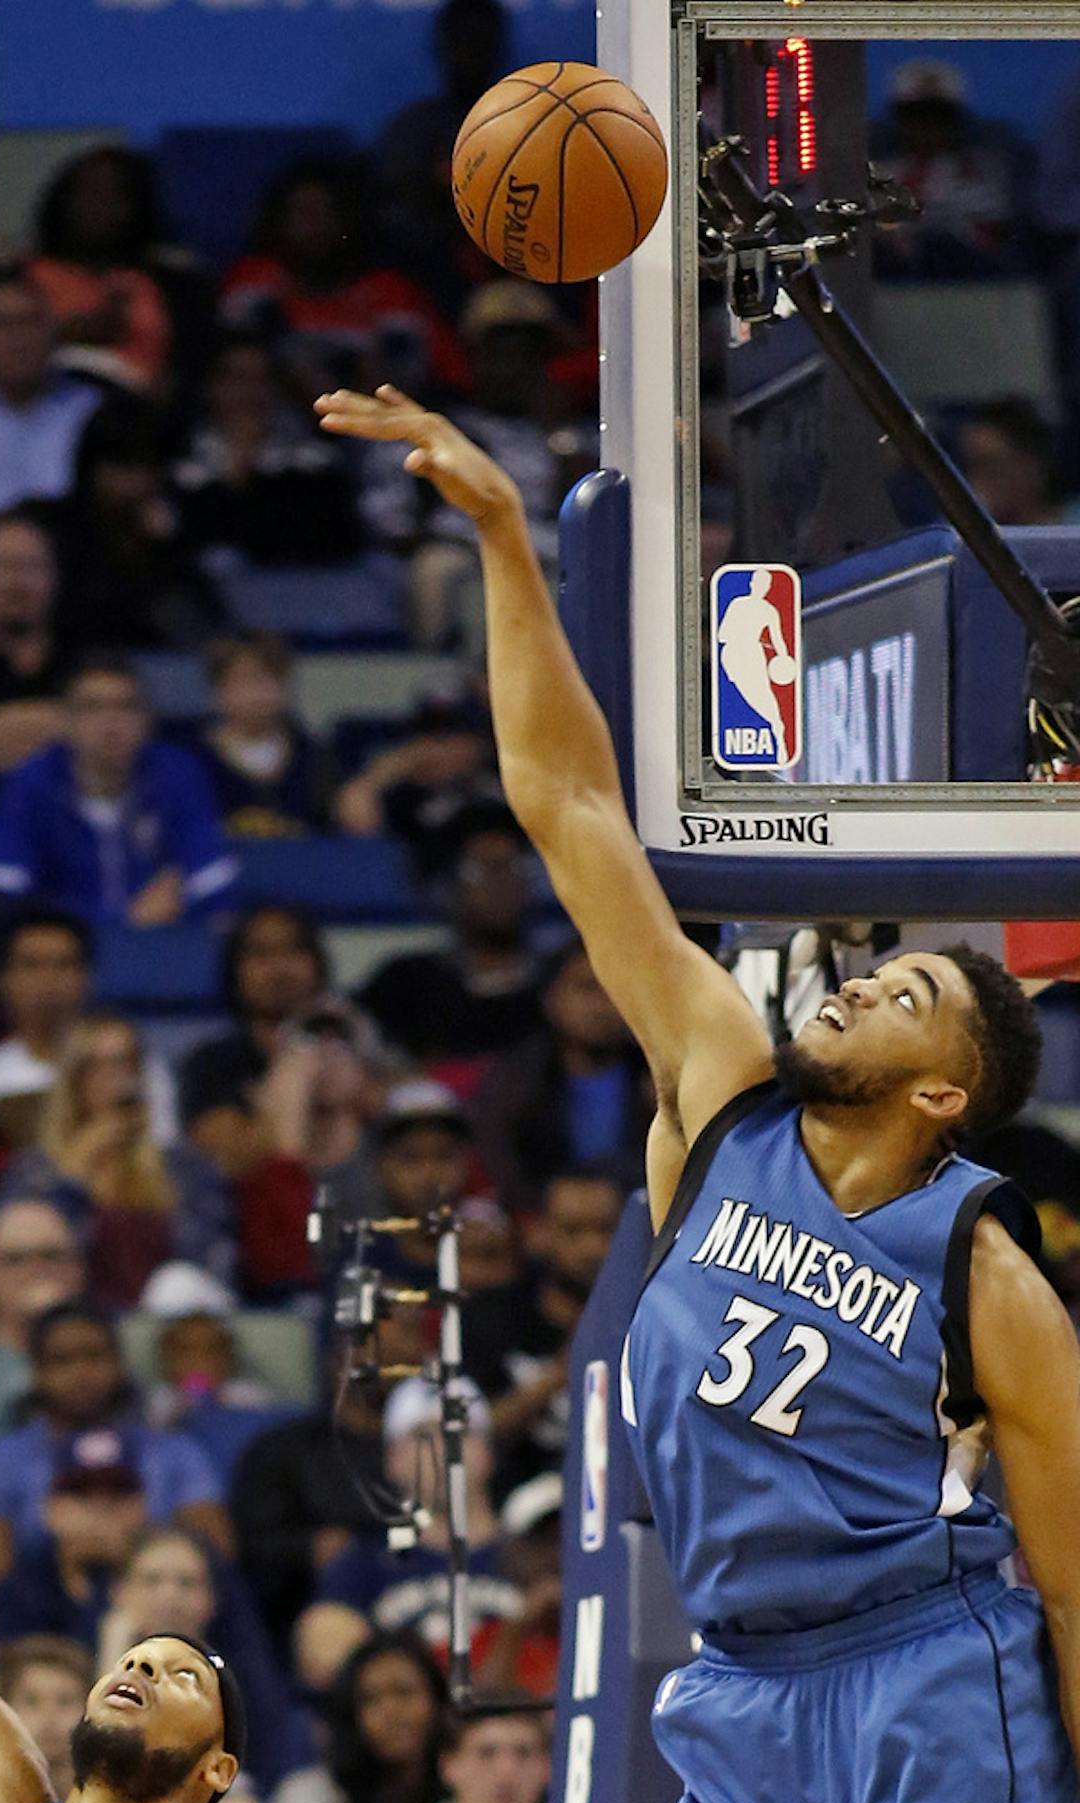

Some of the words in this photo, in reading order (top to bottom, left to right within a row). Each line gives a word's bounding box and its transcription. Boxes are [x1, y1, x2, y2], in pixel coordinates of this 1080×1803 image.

[724, 727, 775, 756] NBA
[680, 813, 829, 848] SPALDING
[689, 1198, 921, 1360] MINNESOTA
[695, 1295, 830, 1437] 32
